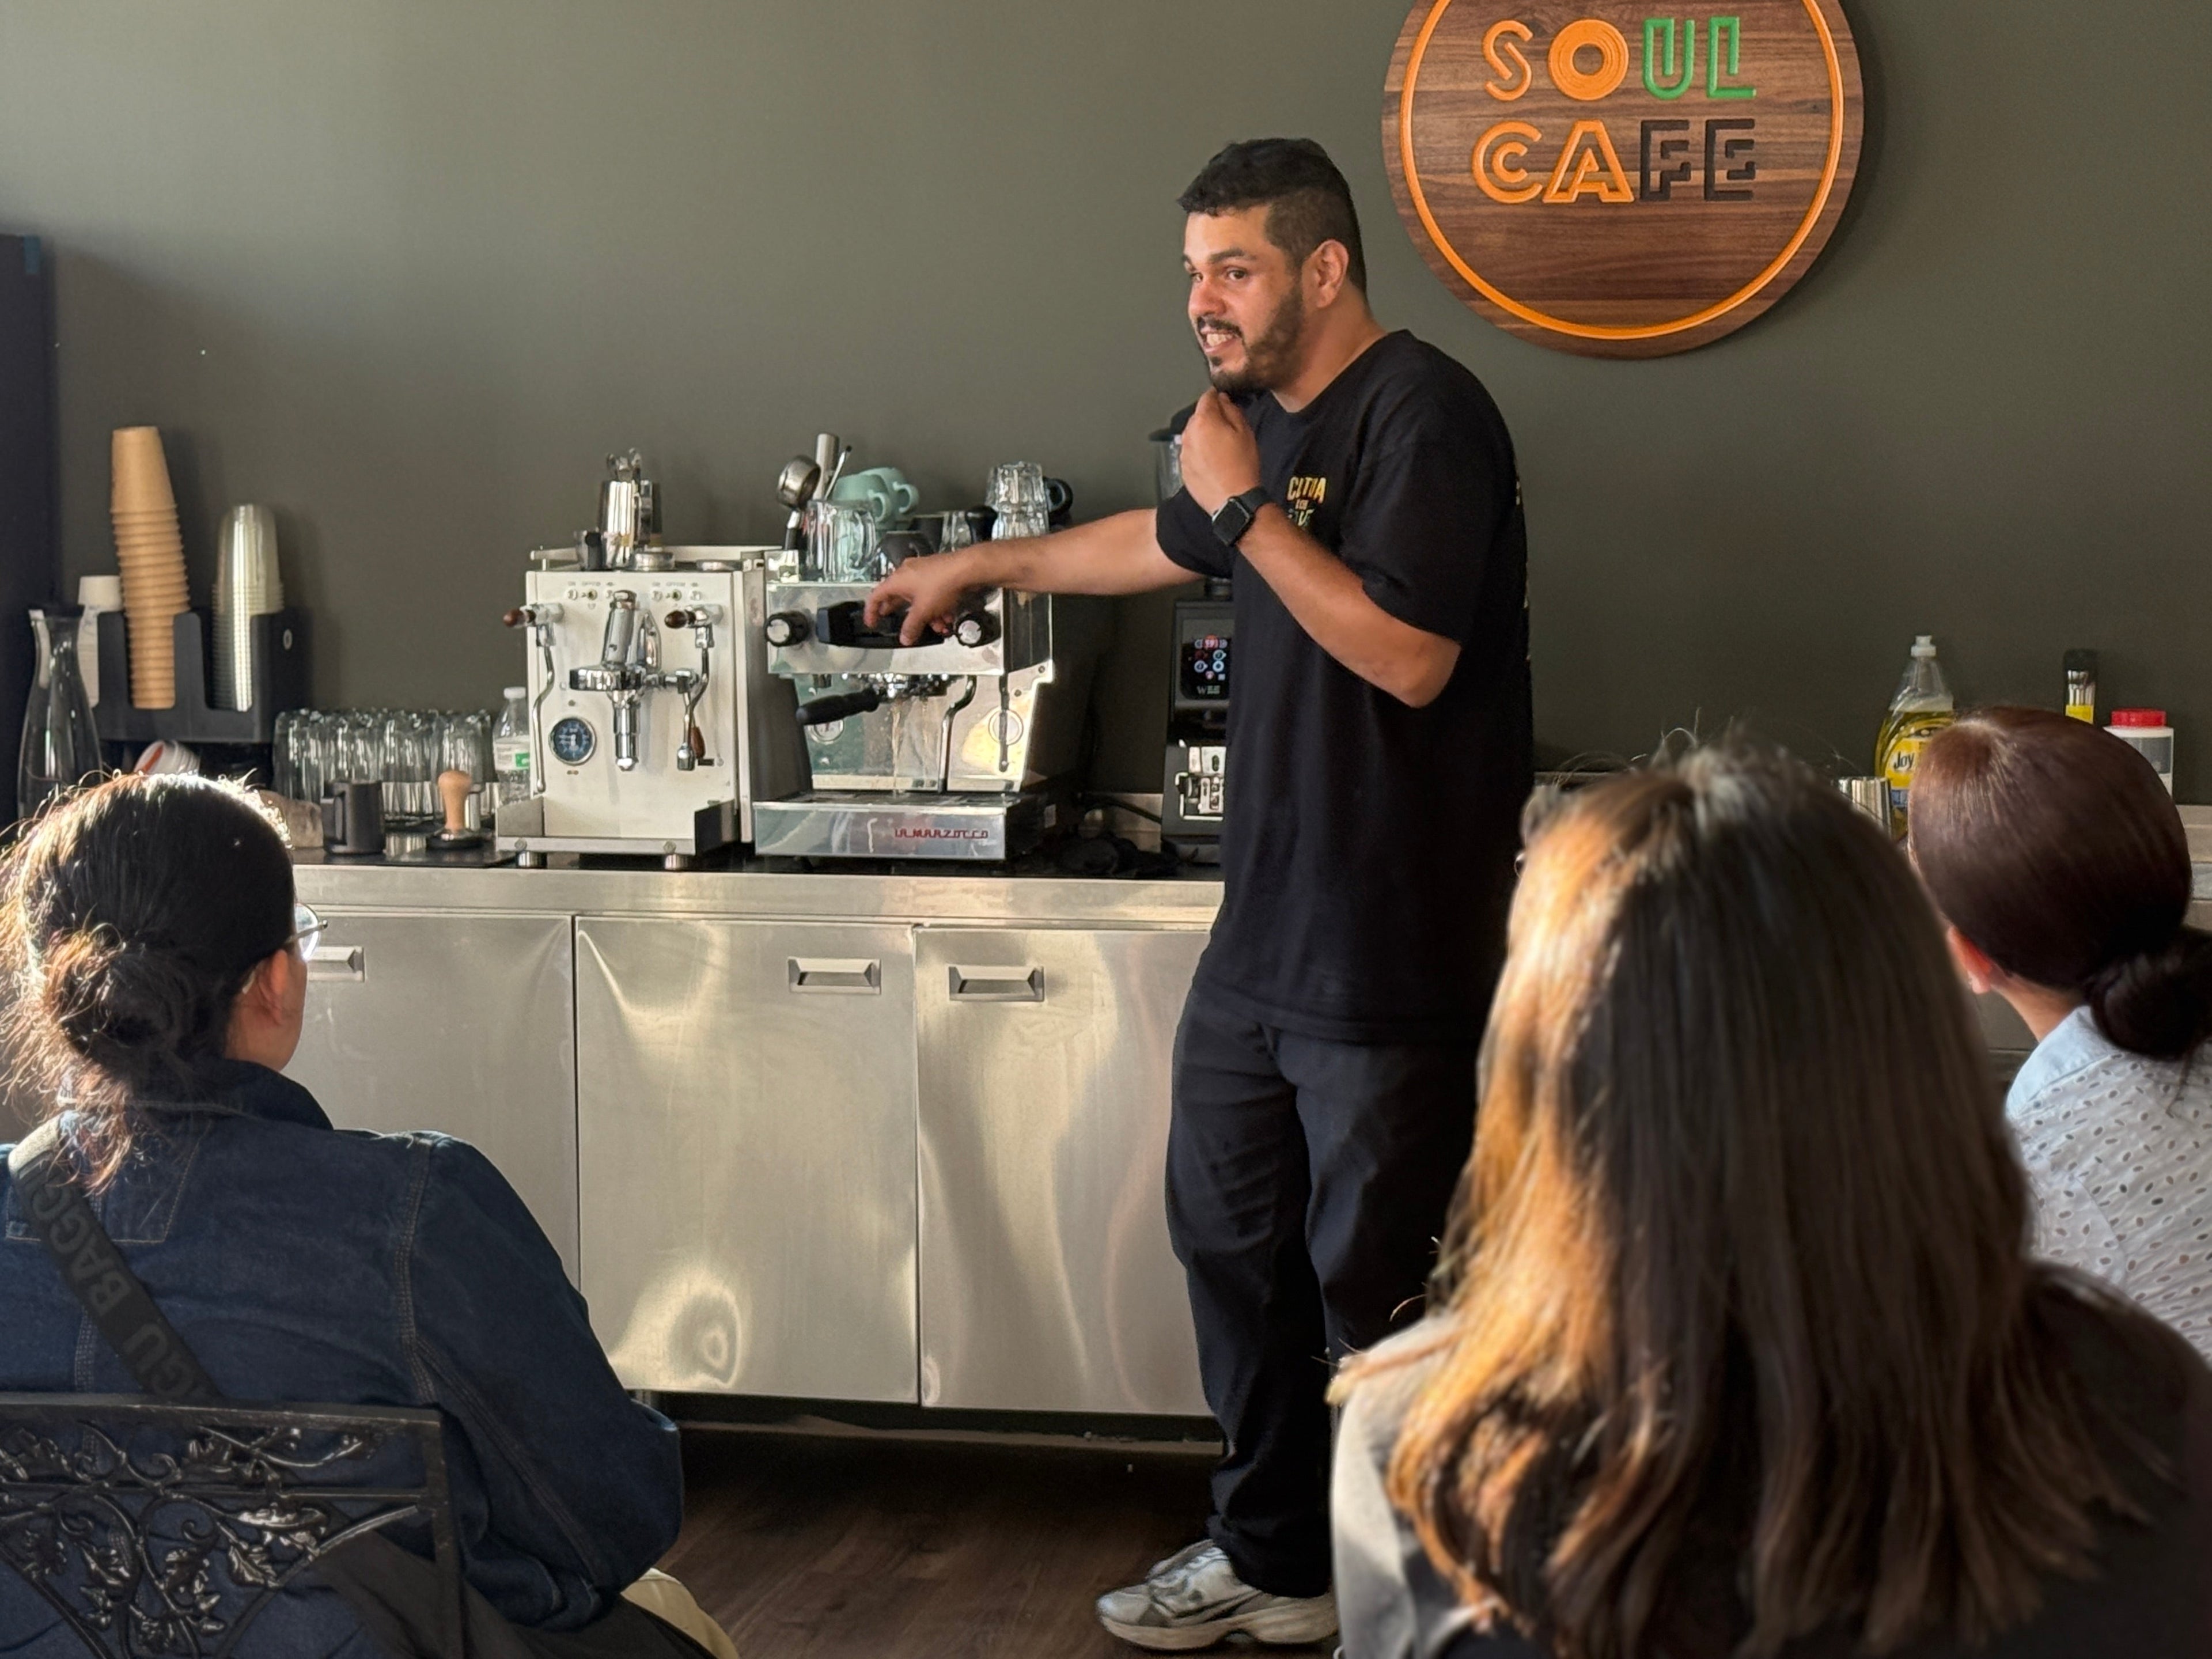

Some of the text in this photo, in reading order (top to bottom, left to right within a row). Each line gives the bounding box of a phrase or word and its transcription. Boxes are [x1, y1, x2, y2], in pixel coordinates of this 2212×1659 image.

[1482, 16, 1756, 101] SOUL
[1471, 119, 1756, 204] CAFE
[1893, 751, 1915, 771] Joy
